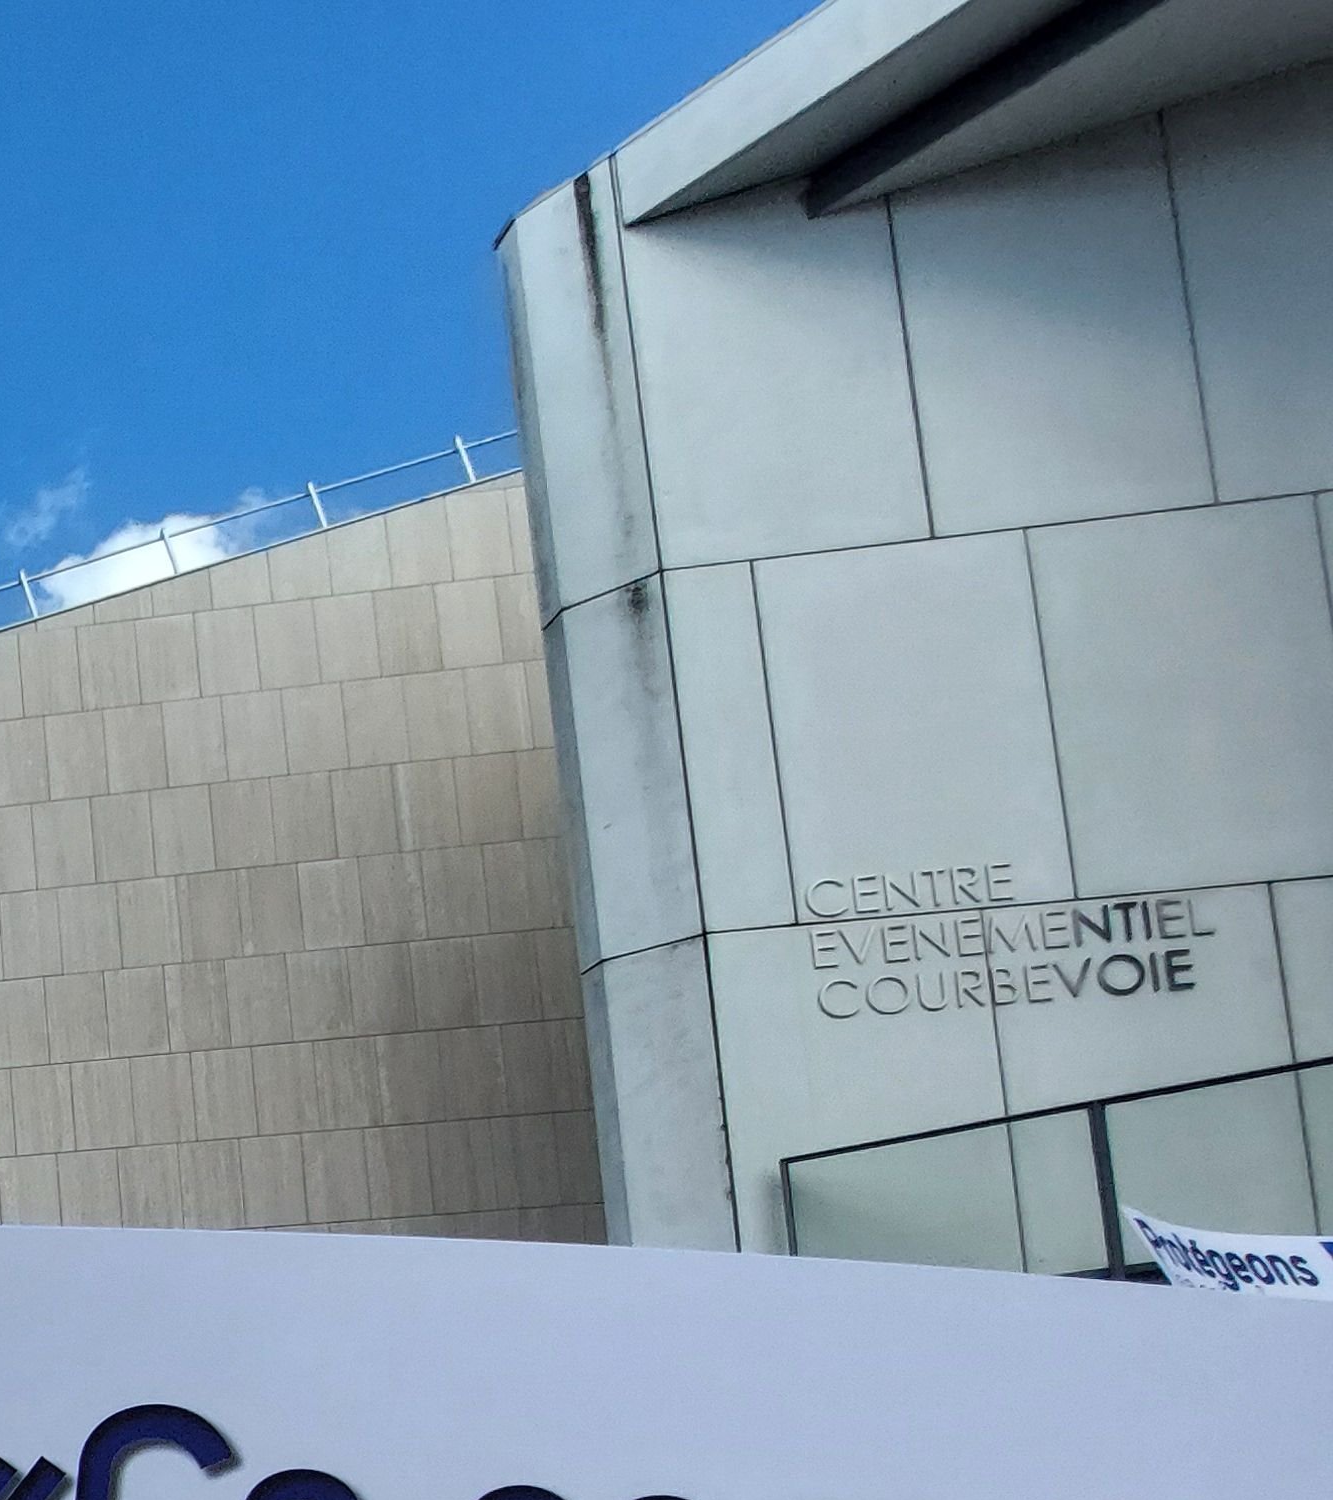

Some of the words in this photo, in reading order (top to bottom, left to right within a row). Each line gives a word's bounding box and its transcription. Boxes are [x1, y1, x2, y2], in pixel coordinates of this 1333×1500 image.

[805, 863, 1013, 918] CENTRE
[809, 898, 1216, 970] EVENEMENTIEL
[817, 948, 1196, 1019] COURBEVOIE
[1133, 1217, 1319, 1290] Protégeons
